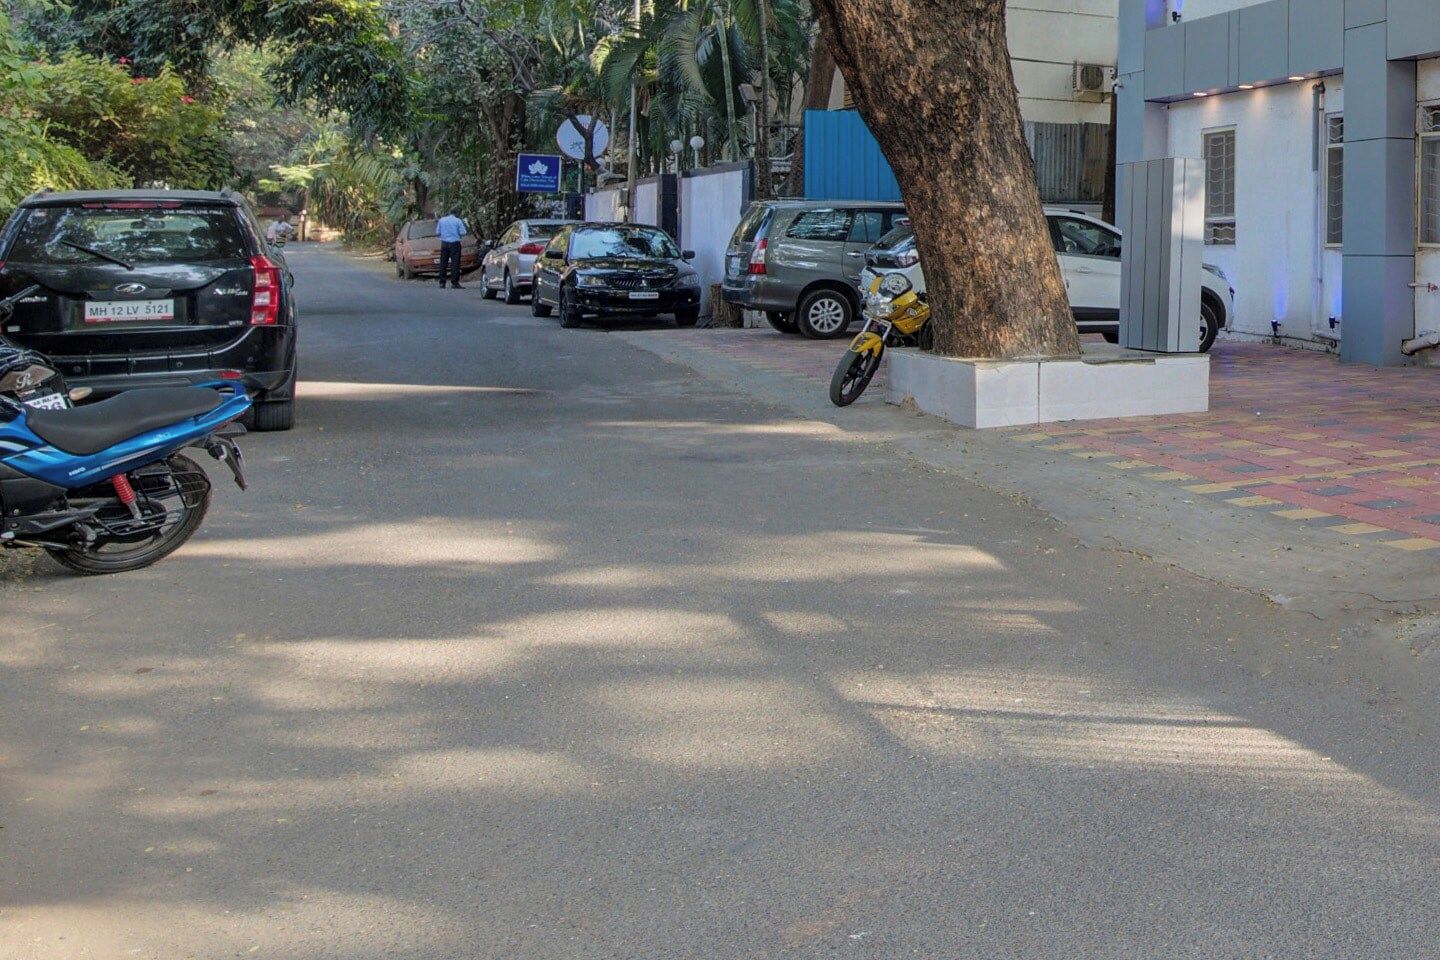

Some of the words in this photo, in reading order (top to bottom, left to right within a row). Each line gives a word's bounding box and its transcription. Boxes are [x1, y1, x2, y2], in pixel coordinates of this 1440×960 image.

[89, 307, 107, 316] MH
[110, 306, 124, 315] 12
[126, 306, 139, 315] LV
[145, 304, 168, 314] 5121
